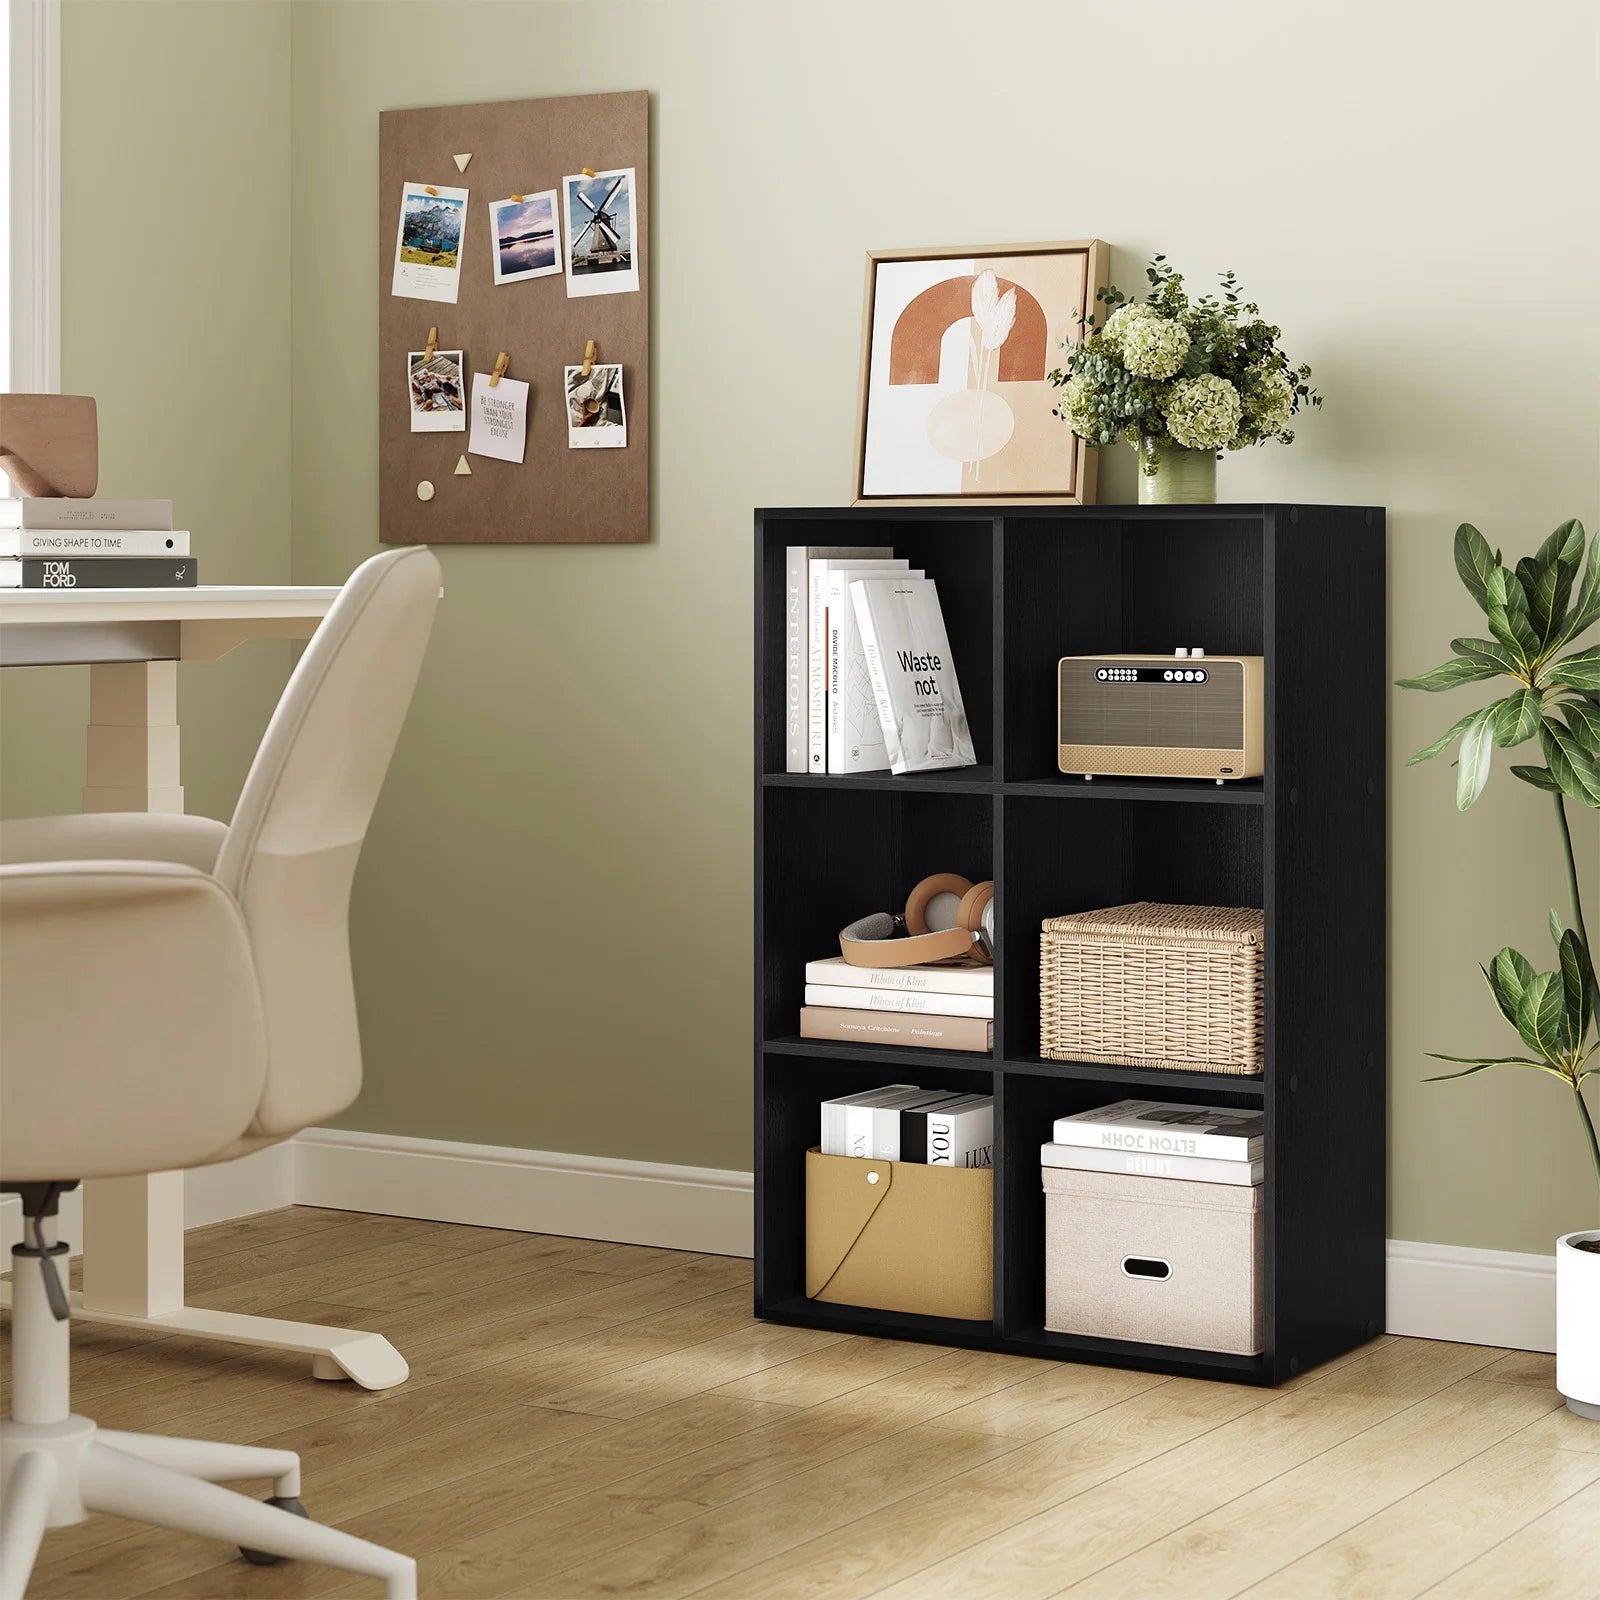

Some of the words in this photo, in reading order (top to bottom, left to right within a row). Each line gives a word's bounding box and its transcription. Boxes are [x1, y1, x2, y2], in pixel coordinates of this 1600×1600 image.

[481, 396, 487, 406] BE
[488, 398, 515, 411] STRONGER
[483, 407, 498, 417] THAN
[500, 410, 513, 420] YOUR
[484, 416, 514, 430] STRONGEST
[490, 427, 508, 439] EXCUSE
[32, 538, 62, 548] GIVING
[63, 538, 89, 548] SHAPE
[91, 539, 102, 548] TO
[104, 538, 122, 548] TIME
[43, 562, 70, 575] TOM
[43, 574, 77, 587] FORD
[790, 586, 799, 737] INTERIORS
[897, 650, 942, 673] Waste
[914, 675, 939, 696] not
[811, 645, 822, 750] ATMOSPHERE
[870, 973, 895, 985] Hilma
[895, 976, 905, 988] af
[906, 975, 927, 987] Klint
[869, 995, 895, 1006] Hilma
[895, 997, 905, 1009] af
[905, 996, 927, 1009] Klint
[840, 1023, 866, 1031] Somaya
[867, 1025, 900, 1033] Critchlow
[911, 1028, 943, 1037] Paintings
[932, 1122, 950, 1163] YOU
[1101, 1132, 1145, 1148] JOHN
[1149, 1137, 1196, 1154] ELTON
[965, 1144, 994, 1168] LUX
